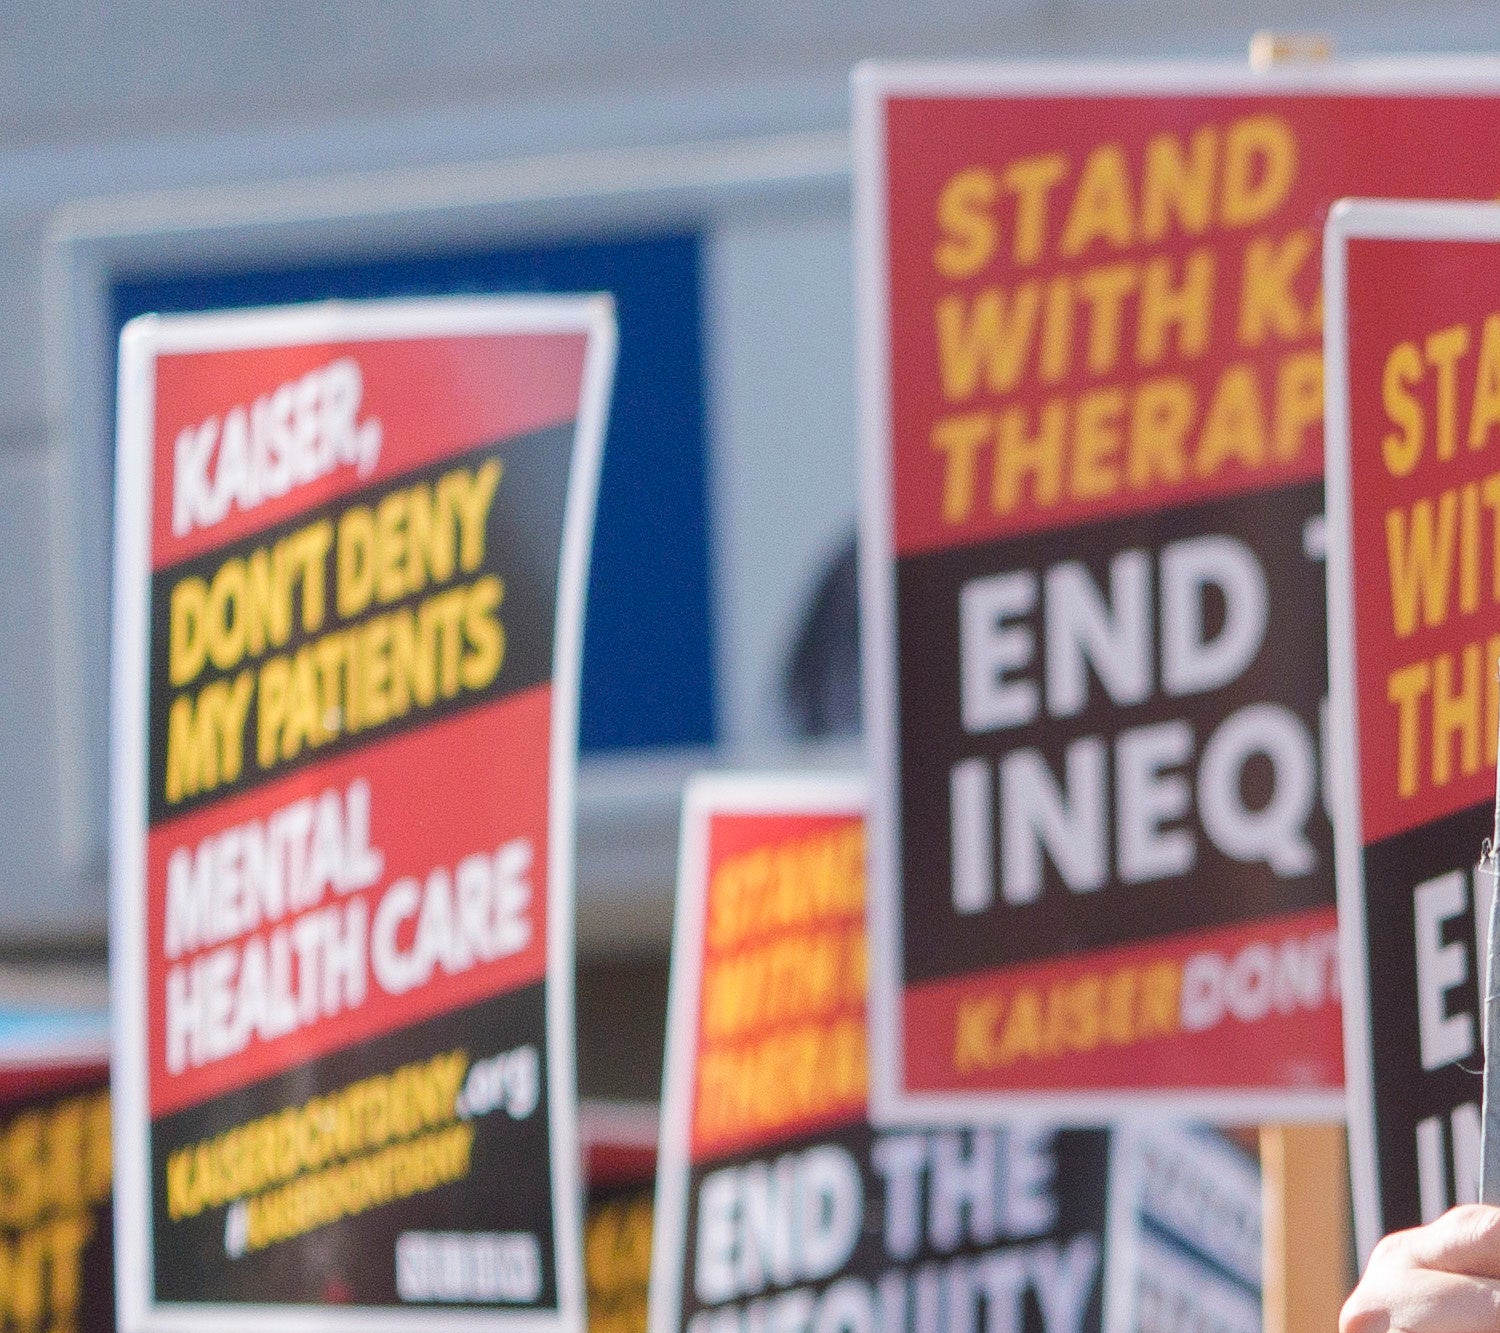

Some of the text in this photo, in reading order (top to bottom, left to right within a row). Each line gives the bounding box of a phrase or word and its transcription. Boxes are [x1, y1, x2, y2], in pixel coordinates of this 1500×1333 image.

[932, 115, 1299, 281] STAND
[934, 250, 1218, 401] WITH
[171, 358, 384, 540] KAISER,
[168, 458, 507, 690] DON'T DENY
[958, 531, 1270, 735] END
[165, 576, 508, 806] MY PATIENTS
[164, 776, 387, 962] MENTAL
[164, 838, 534, 1077] HEALTH CARE
[694, 1140, 866, 1306] END
[873, 1132, 1058, 1262] THE
